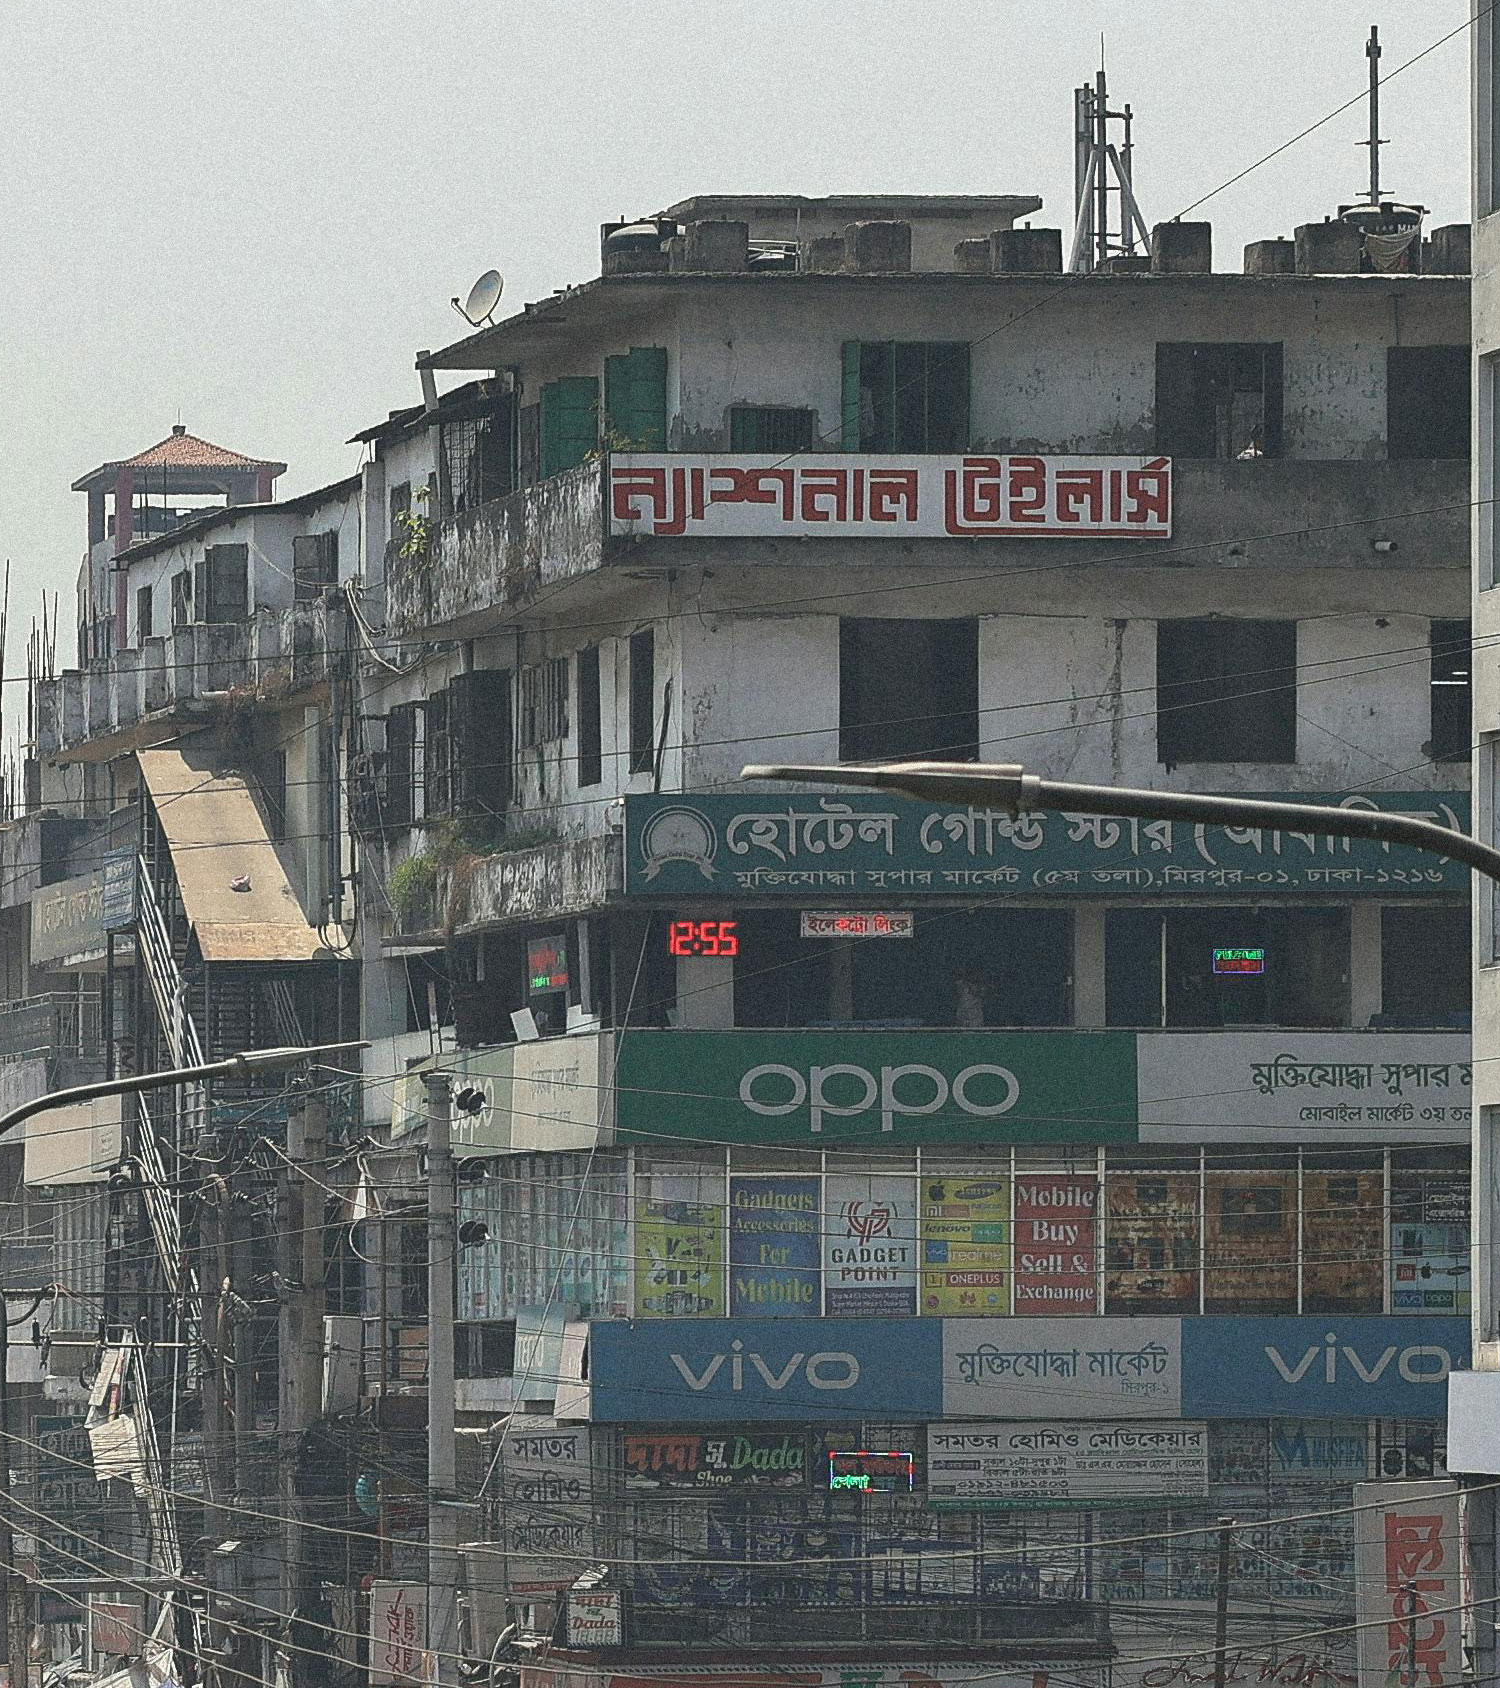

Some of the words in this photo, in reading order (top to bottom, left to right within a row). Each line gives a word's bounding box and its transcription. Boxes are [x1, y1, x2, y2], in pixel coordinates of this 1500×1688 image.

[612, 467, 918, 535] ন্যাশনাল
[944, 457, 1169, 537] টেইলার্স
[726, 798, 899, 862] হোটেল
[733, 867, 855, 888] মুক্তিযোদ্ধা
[867, 869, 931, 888] সুপার
[941, 866, 1020, 886] মার্কেট
[669, 921, 738, 957] 12:55
[1250, 1054, 1374, 1095] মুক্তিযোদ্ধা
[1381, 1063, 1451, 1096] সুপার
[739, 1063, 1020, 1132] oppo
[1300, 1103, 1361, 1122] মোবাইল
[1367, 1103, 1414, 1122] মার্কেট
[1018, 1186, 1095, 1208] Mobile
[1032, 1221, 1079, 1246] Buy
[759, 1243, 789, 1265] For
[831, 1247, 909, 1264] GADGET
[1021, 1254, 1063, 1275] Sell
[1072, 1254, 1088, 1274] &
[841, 1266, 899, 1282] POINT
[950, 1274, 1001, 1285] ONEPLUS
[737, 1277, 814, 1303] Mobile
[1016, 1284, 1094, 1302] Exchange
[670, 1339, 861, 1391] vivo
[956, 1341, 1079, 1386] মুক্তিযোদ্ধা
[1088, 1339, 1170, 1378] মার্কেট
[1265, 1331, 1450, 1384] vivo
[933, 1434, 1001, 1450] সমতর
[1009, 1429, 1079, 1449] হোমিও
[1089, 1428, 1202, 1448] মেডিকেয়ার
[625, 1436, 698, 1474] দাদা
[730, 1435, 805, 1470] Dada
[697, 1471, 733, 1487] Shoe
